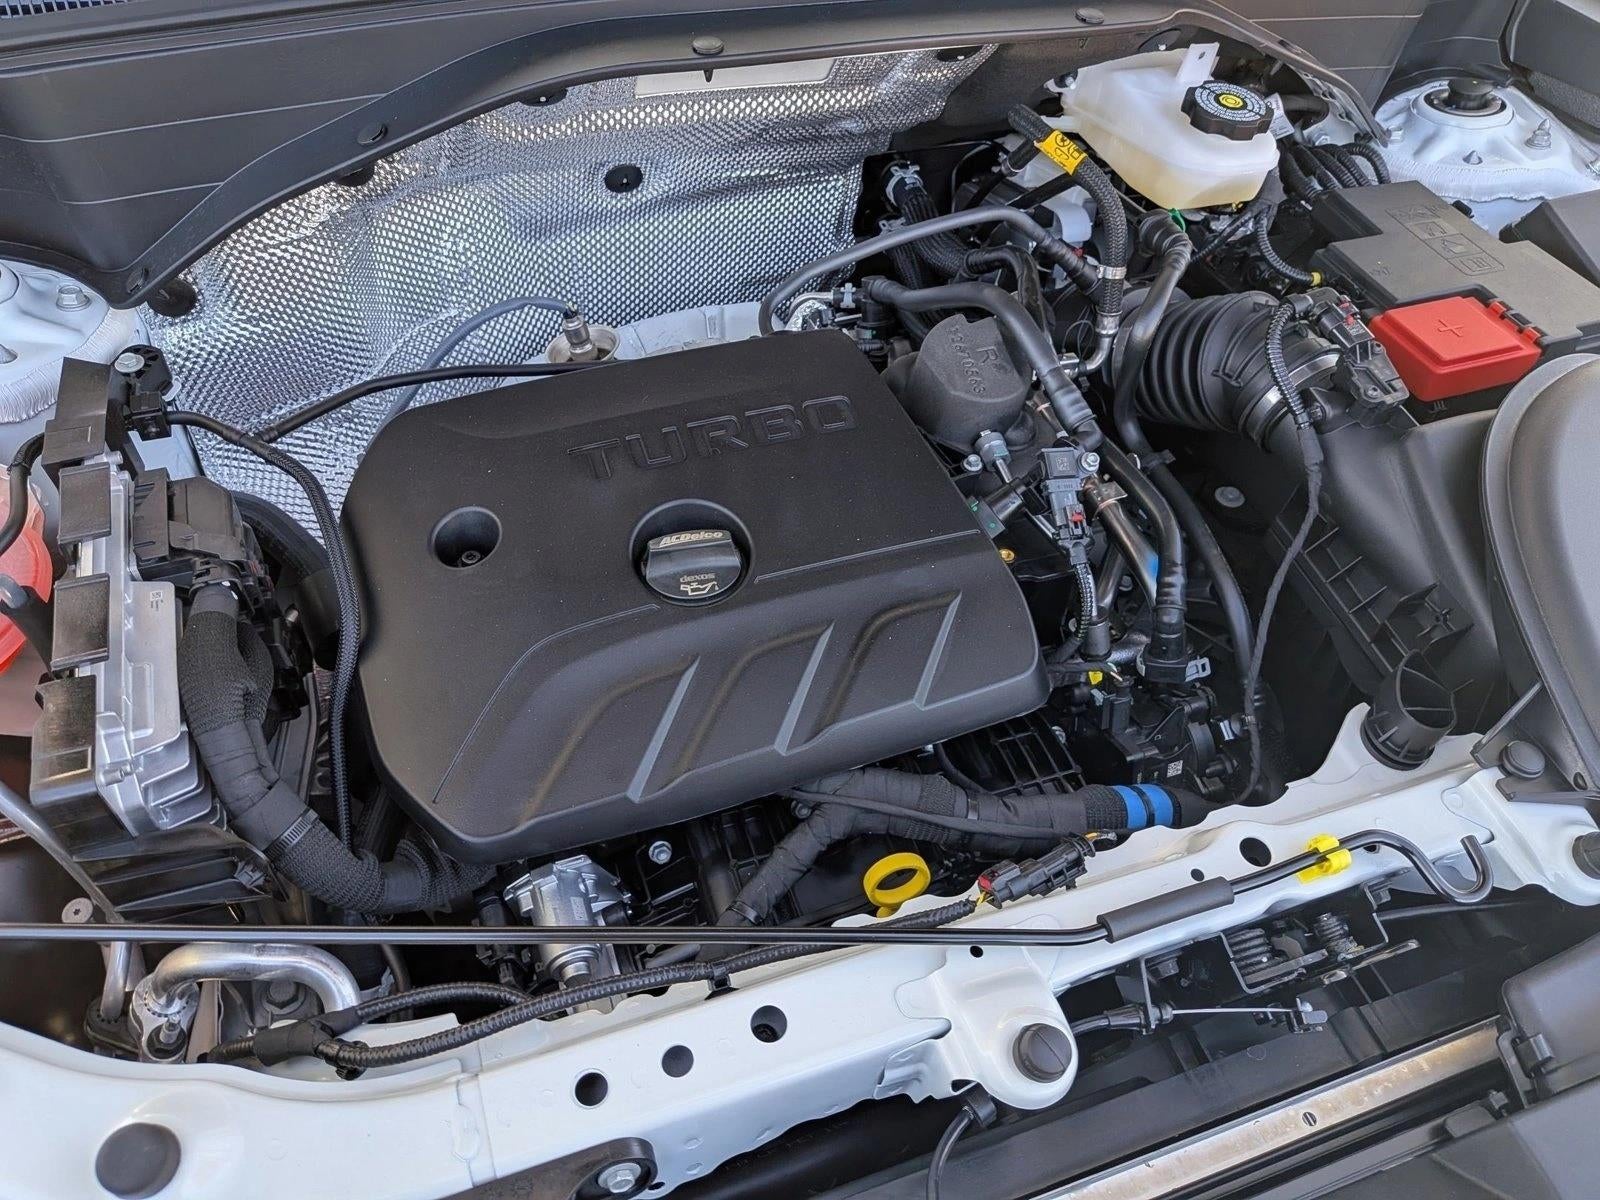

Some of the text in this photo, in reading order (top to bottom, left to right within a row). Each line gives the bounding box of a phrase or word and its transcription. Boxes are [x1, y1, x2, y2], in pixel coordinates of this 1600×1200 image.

[567, 395, 858, 479] TURBO
[660, 531, 723, 547] ACDelco
[680, 573, 716, 582] dexos
